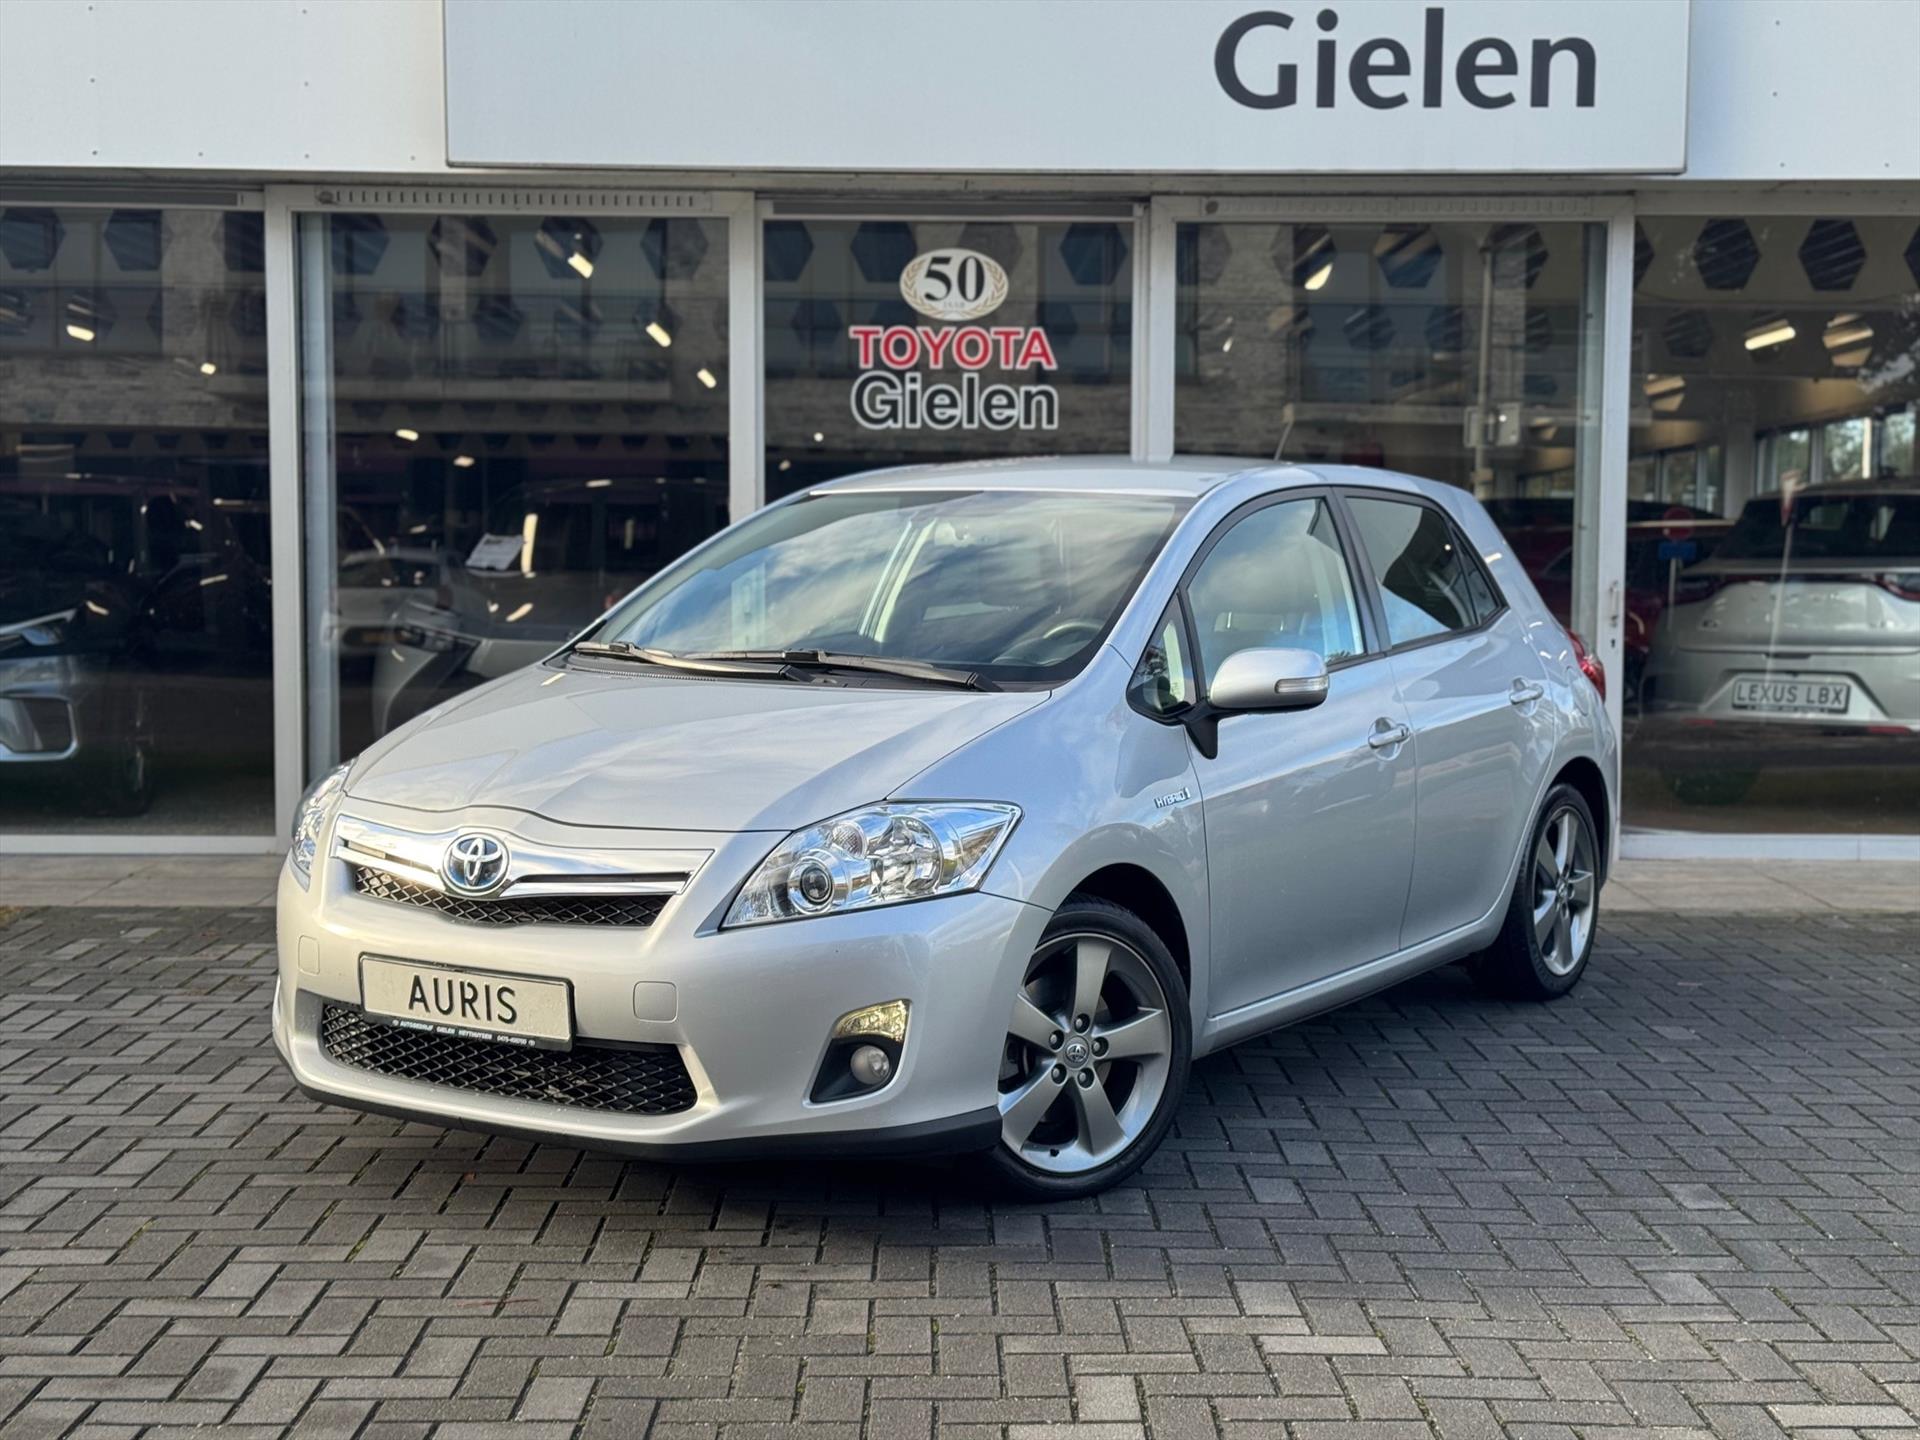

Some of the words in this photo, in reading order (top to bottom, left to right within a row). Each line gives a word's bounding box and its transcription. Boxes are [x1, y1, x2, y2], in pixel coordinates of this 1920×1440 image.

[1214, 7, 1597, 110] Gielen
[924, 255, 985, 303] 50
[849, 326, 1059, 370] TOYOTA
[851, 370, 1059, 430] Gielen
[1737, 684, 1798, 704] LEXUS
[1806, 686, 1843, 705] LBX
[408, 974, 517, 1024] AURIS
